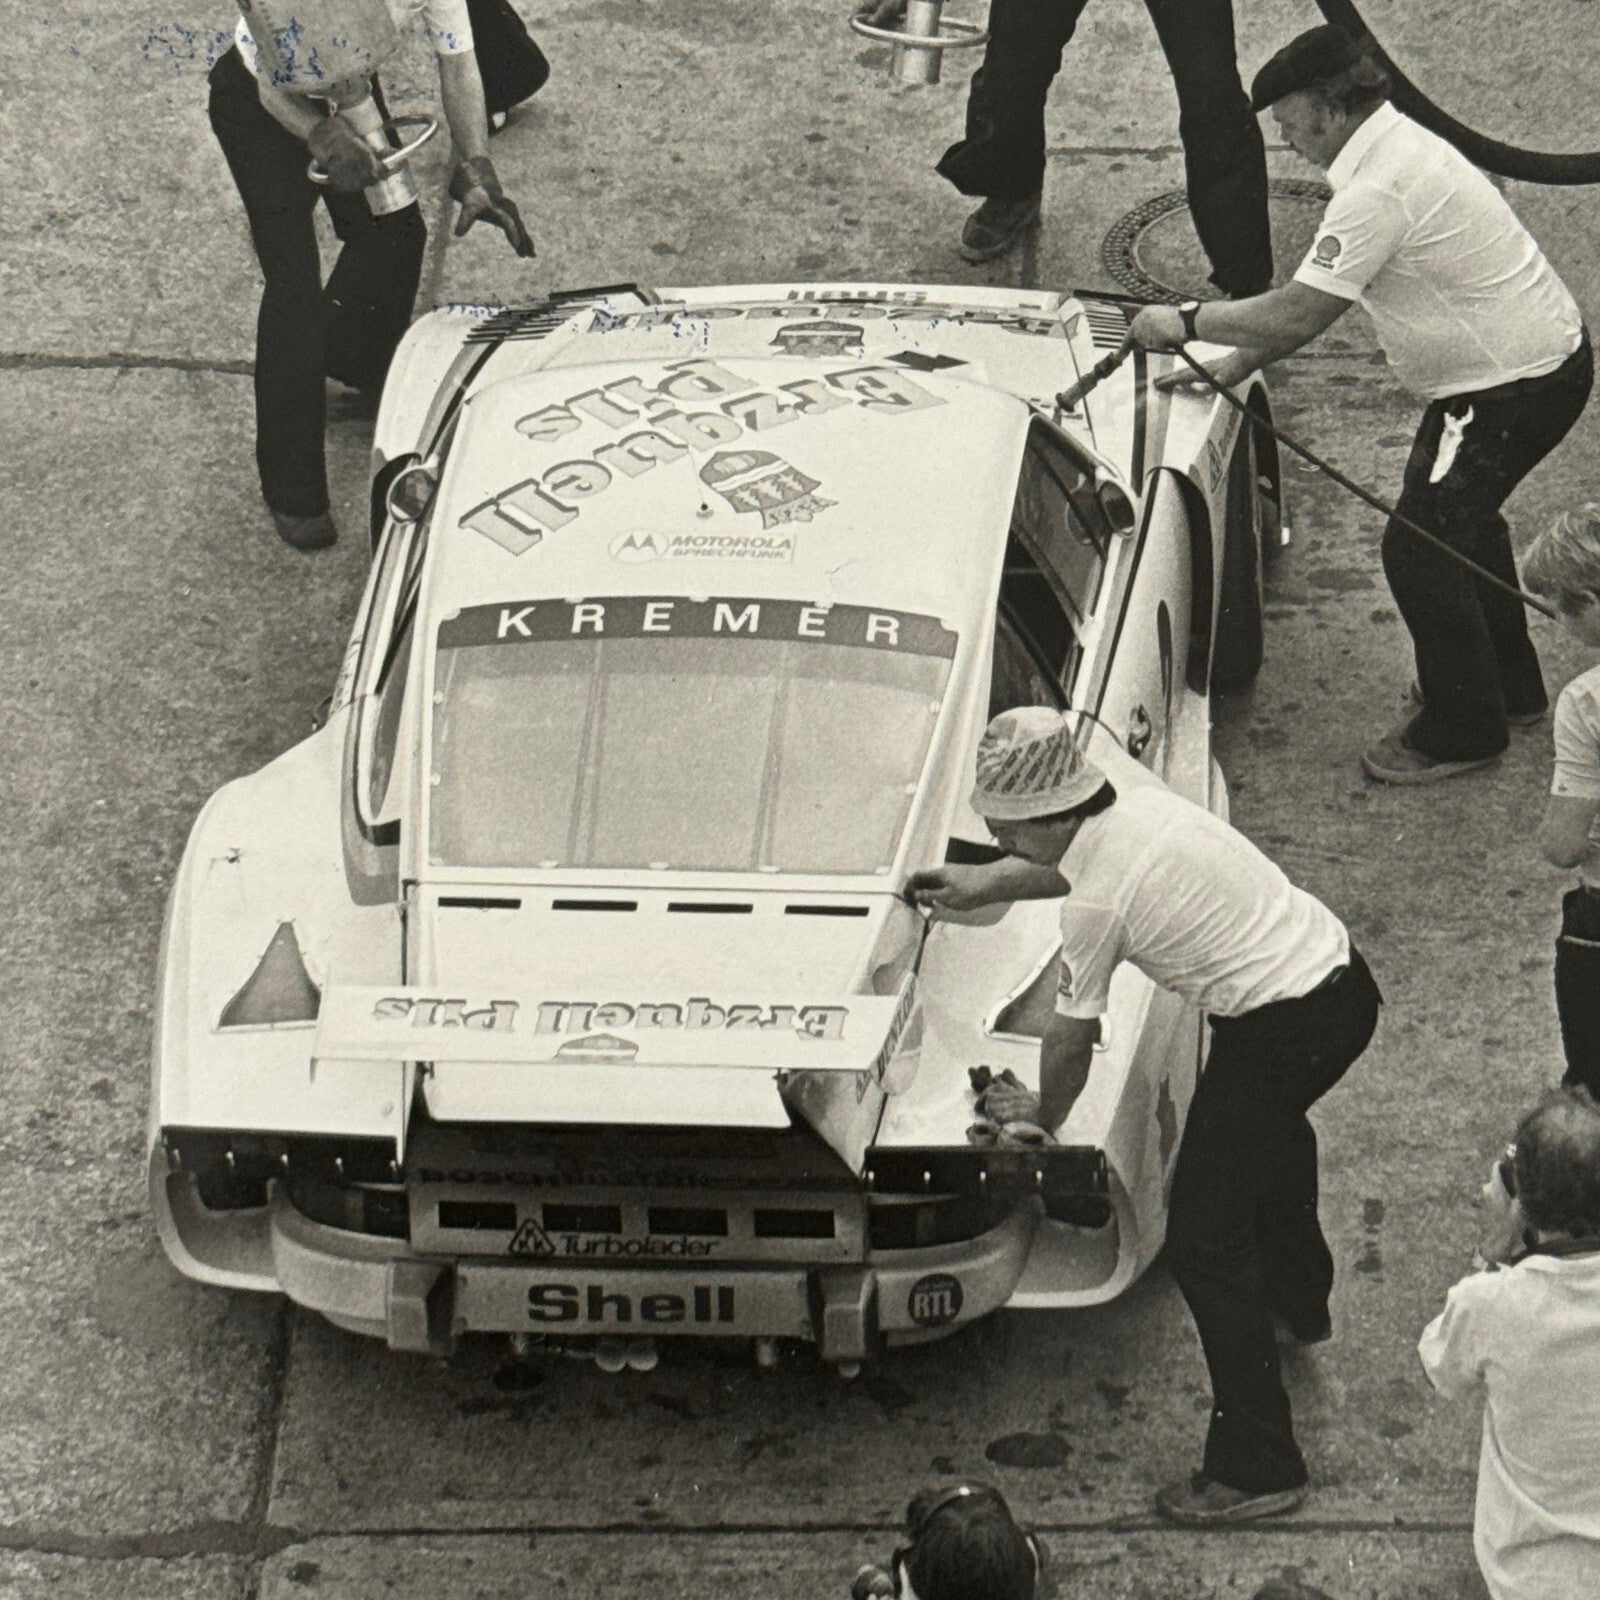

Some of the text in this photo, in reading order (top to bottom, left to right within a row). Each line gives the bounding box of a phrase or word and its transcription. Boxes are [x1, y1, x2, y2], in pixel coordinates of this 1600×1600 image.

[515, 360, 758, 443] Pils
[458, 367, 946, 556] Erzquell
[671, 535, 792, 549] MOTOROLA
[497, 603, 901, 647] KREMER
[372, 997, 849, 1041] Erzquell Pils
[560, 1233, 719, 1256] Turbolader
[526, 1284, 736, 1322] Shell
[913, 1290, 957, 1318] RTL
